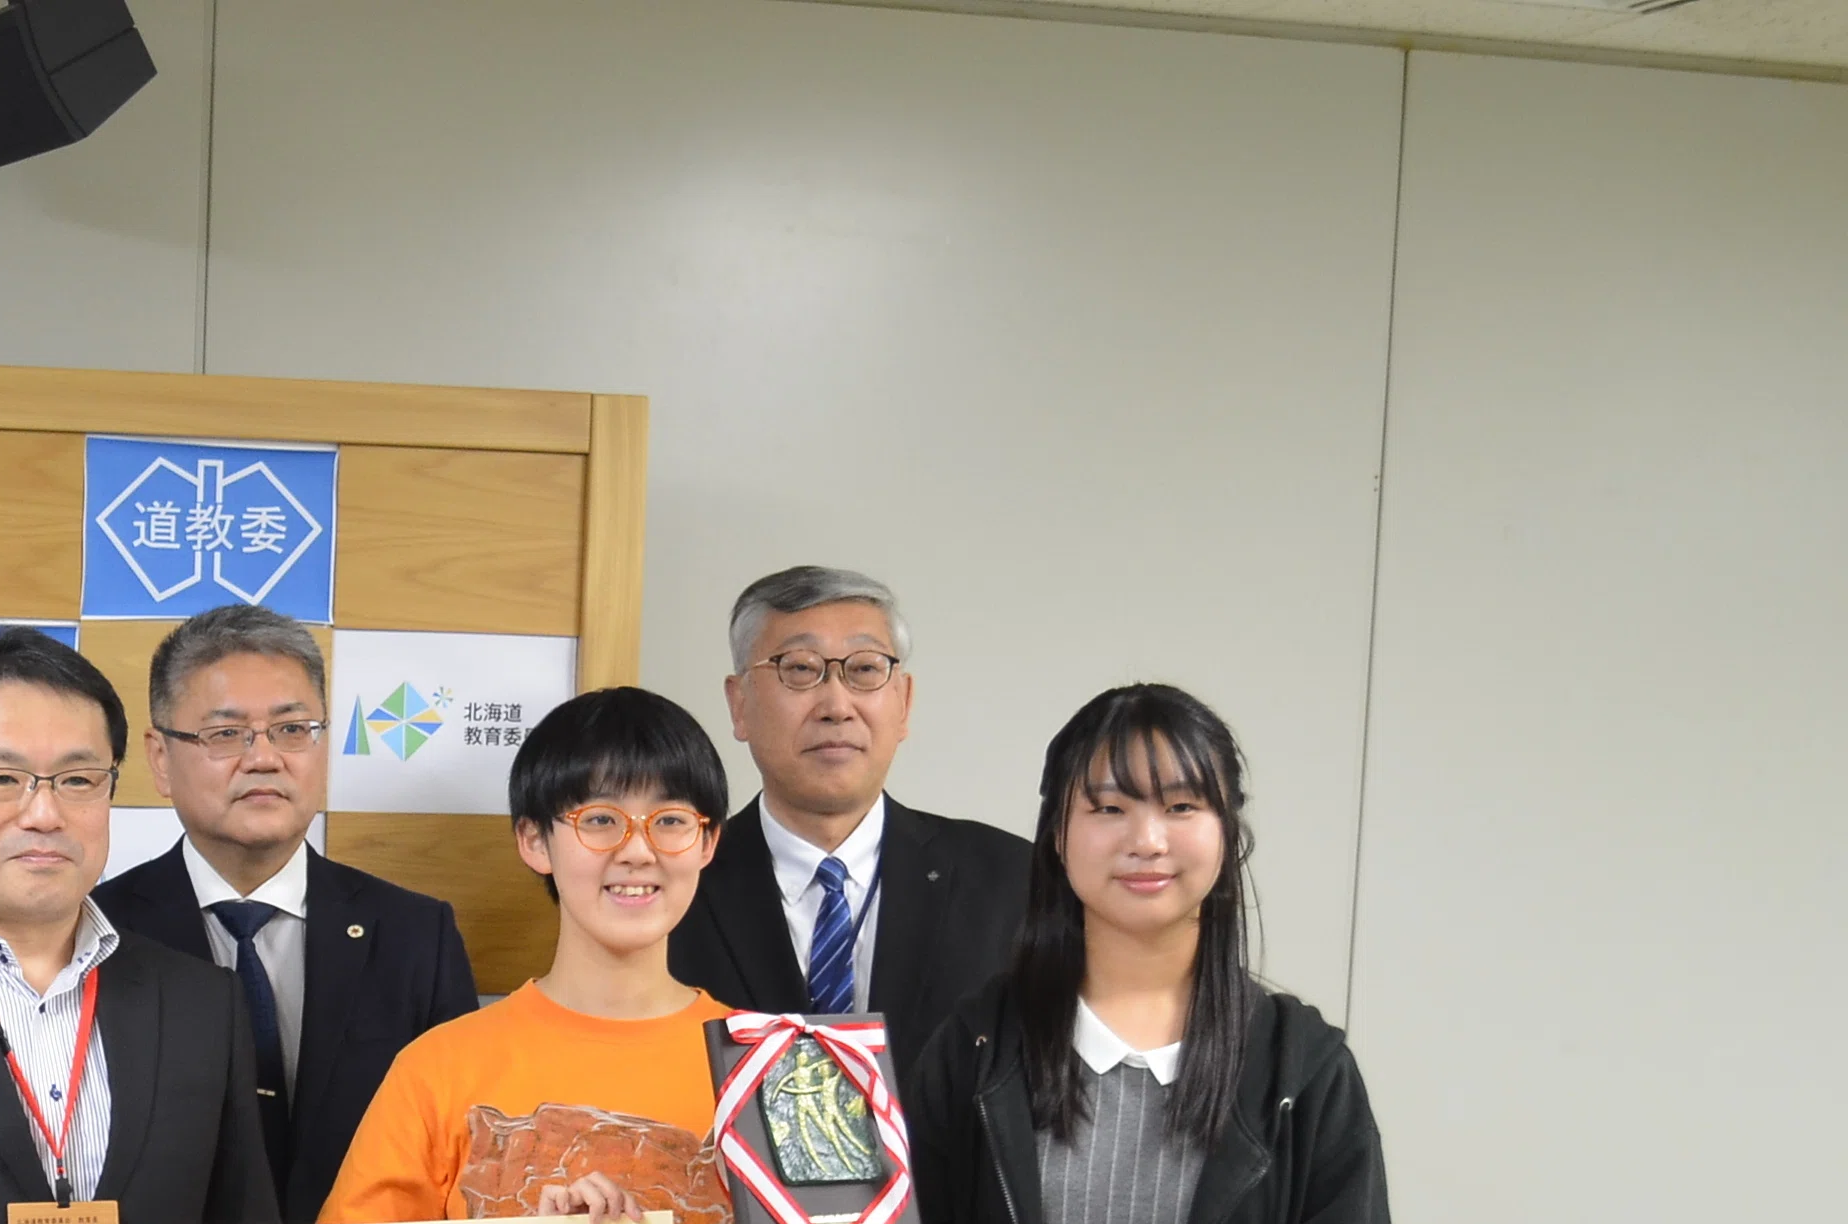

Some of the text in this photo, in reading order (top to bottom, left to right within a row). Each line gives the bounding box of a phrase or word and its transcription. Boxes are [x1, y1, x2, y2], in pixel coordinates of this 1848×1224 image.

[132, 500, 287, 554] 道教委
[464, 702, 522, 723] 北海道
[464, 726, 533, 747] 教育委
